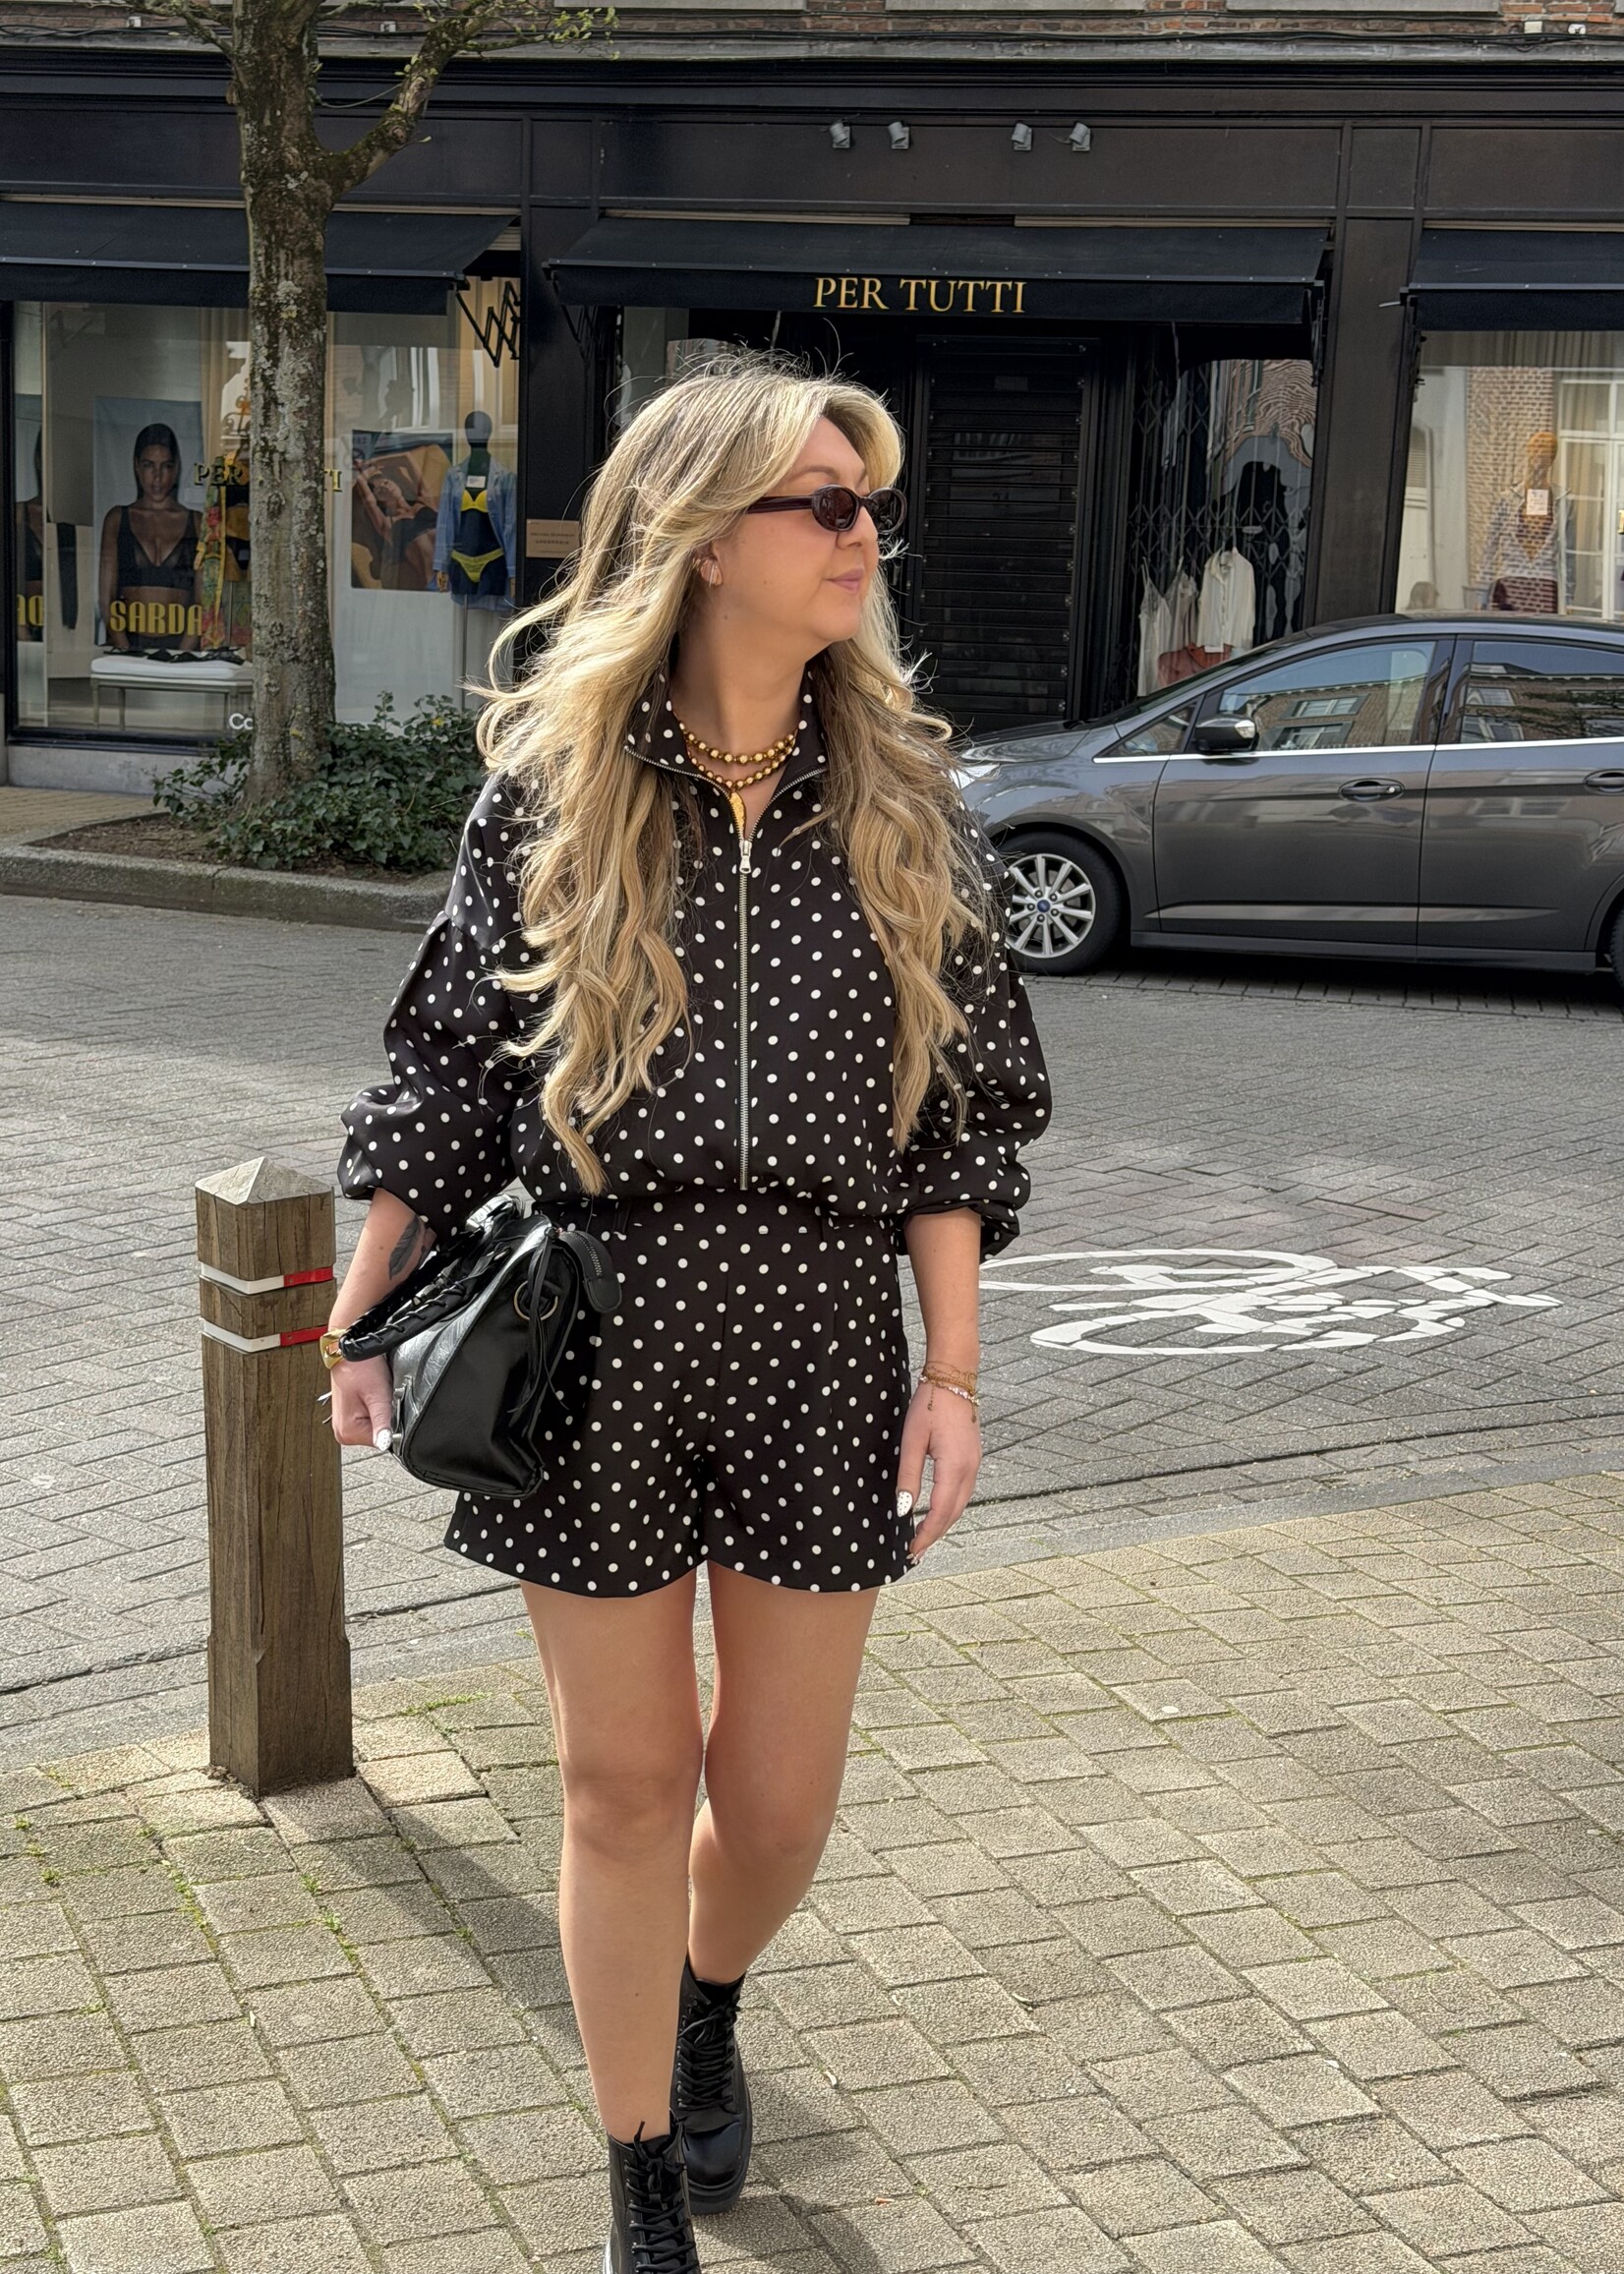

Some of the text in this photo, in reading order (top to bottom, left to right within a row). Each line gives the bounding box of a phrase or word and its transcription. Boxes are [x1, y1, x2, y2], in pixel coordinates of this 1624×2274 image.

[813, 277, 1027, 314] PER TUTTI
[194, 462, 244, 487] PER
[109, 599, 203, 636] SARDA
